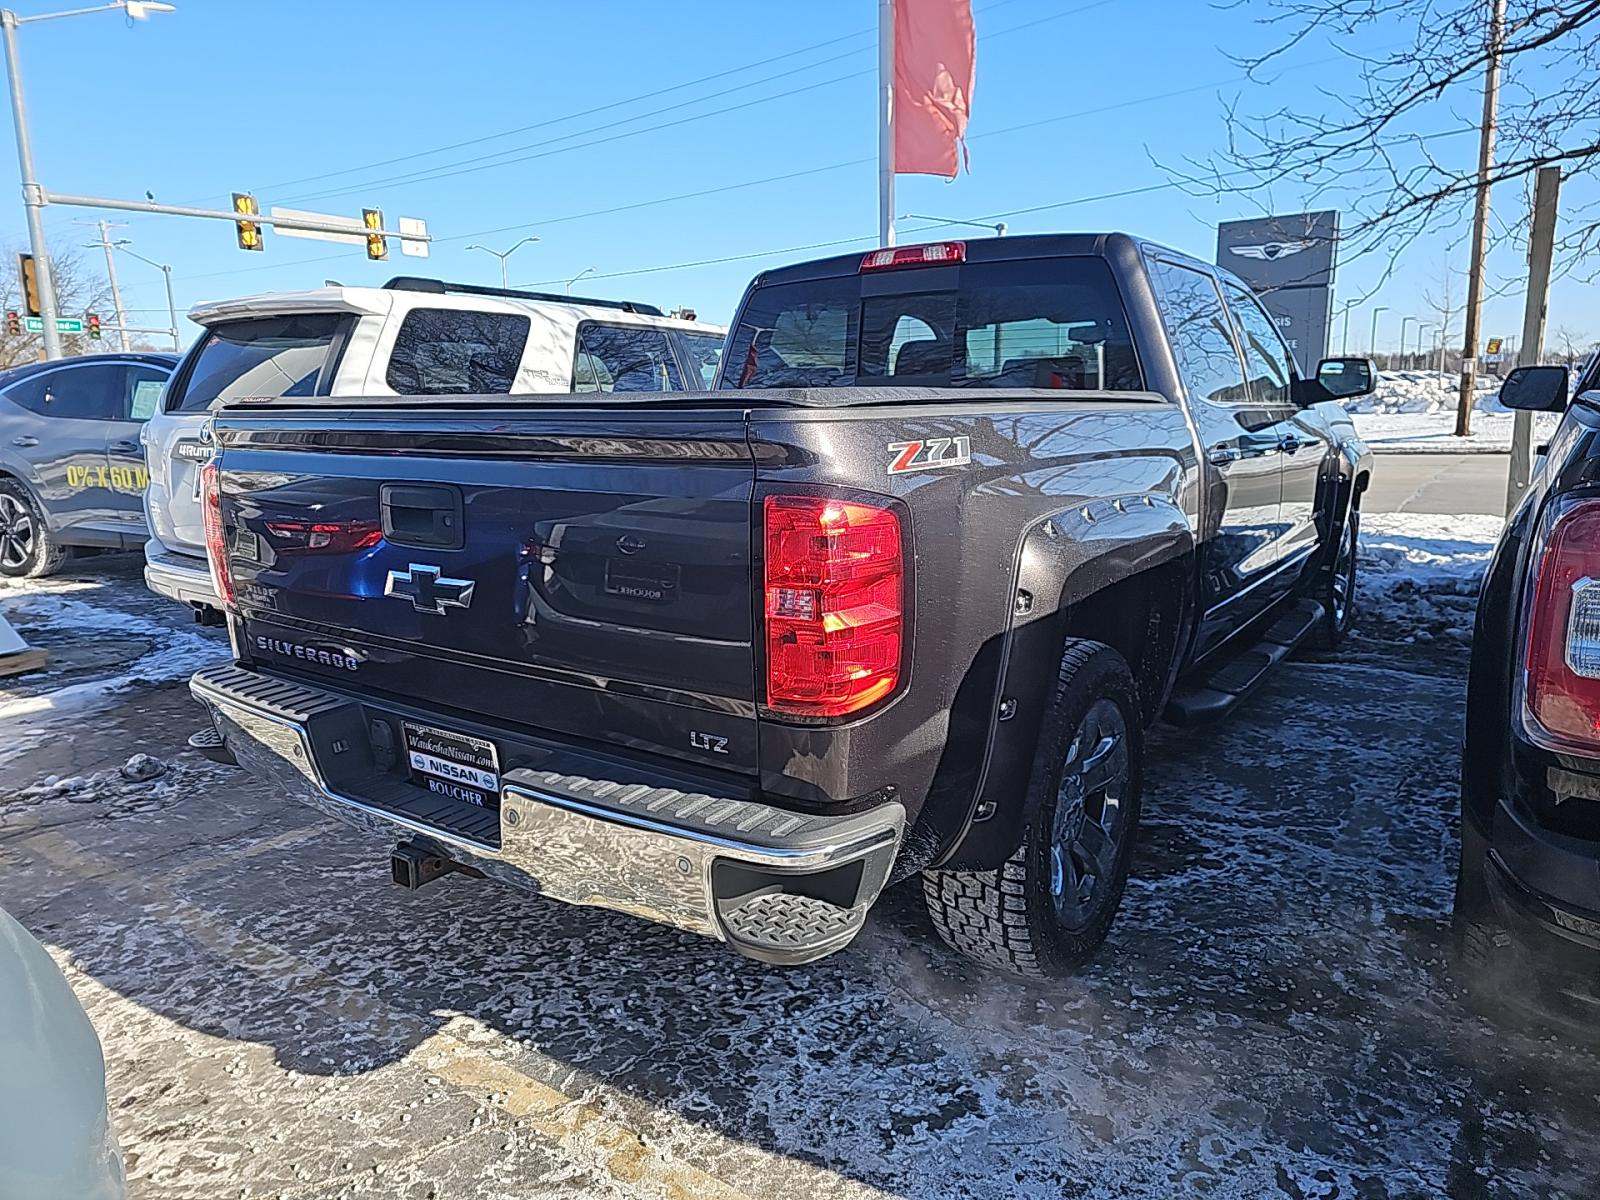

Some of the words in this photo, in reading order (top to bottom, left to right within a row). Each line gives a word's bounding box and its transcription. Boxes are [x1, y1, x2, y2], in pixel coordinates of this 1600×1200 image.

[887, 436, 971, 475] Z71
[66, 465, 93, 488] 0%
[99, 467, 110, 489] X
[110, 467, 133, 490] 60
[256, 635, 359, 672] SILVERADO
[408, 734, 495, 769] WaukeshaNissan.com
[690, 731, 729, 754] LTZ
[429, 760, 479, 783] NISSAN
[428, 779, 484, 808] BOUCHER
